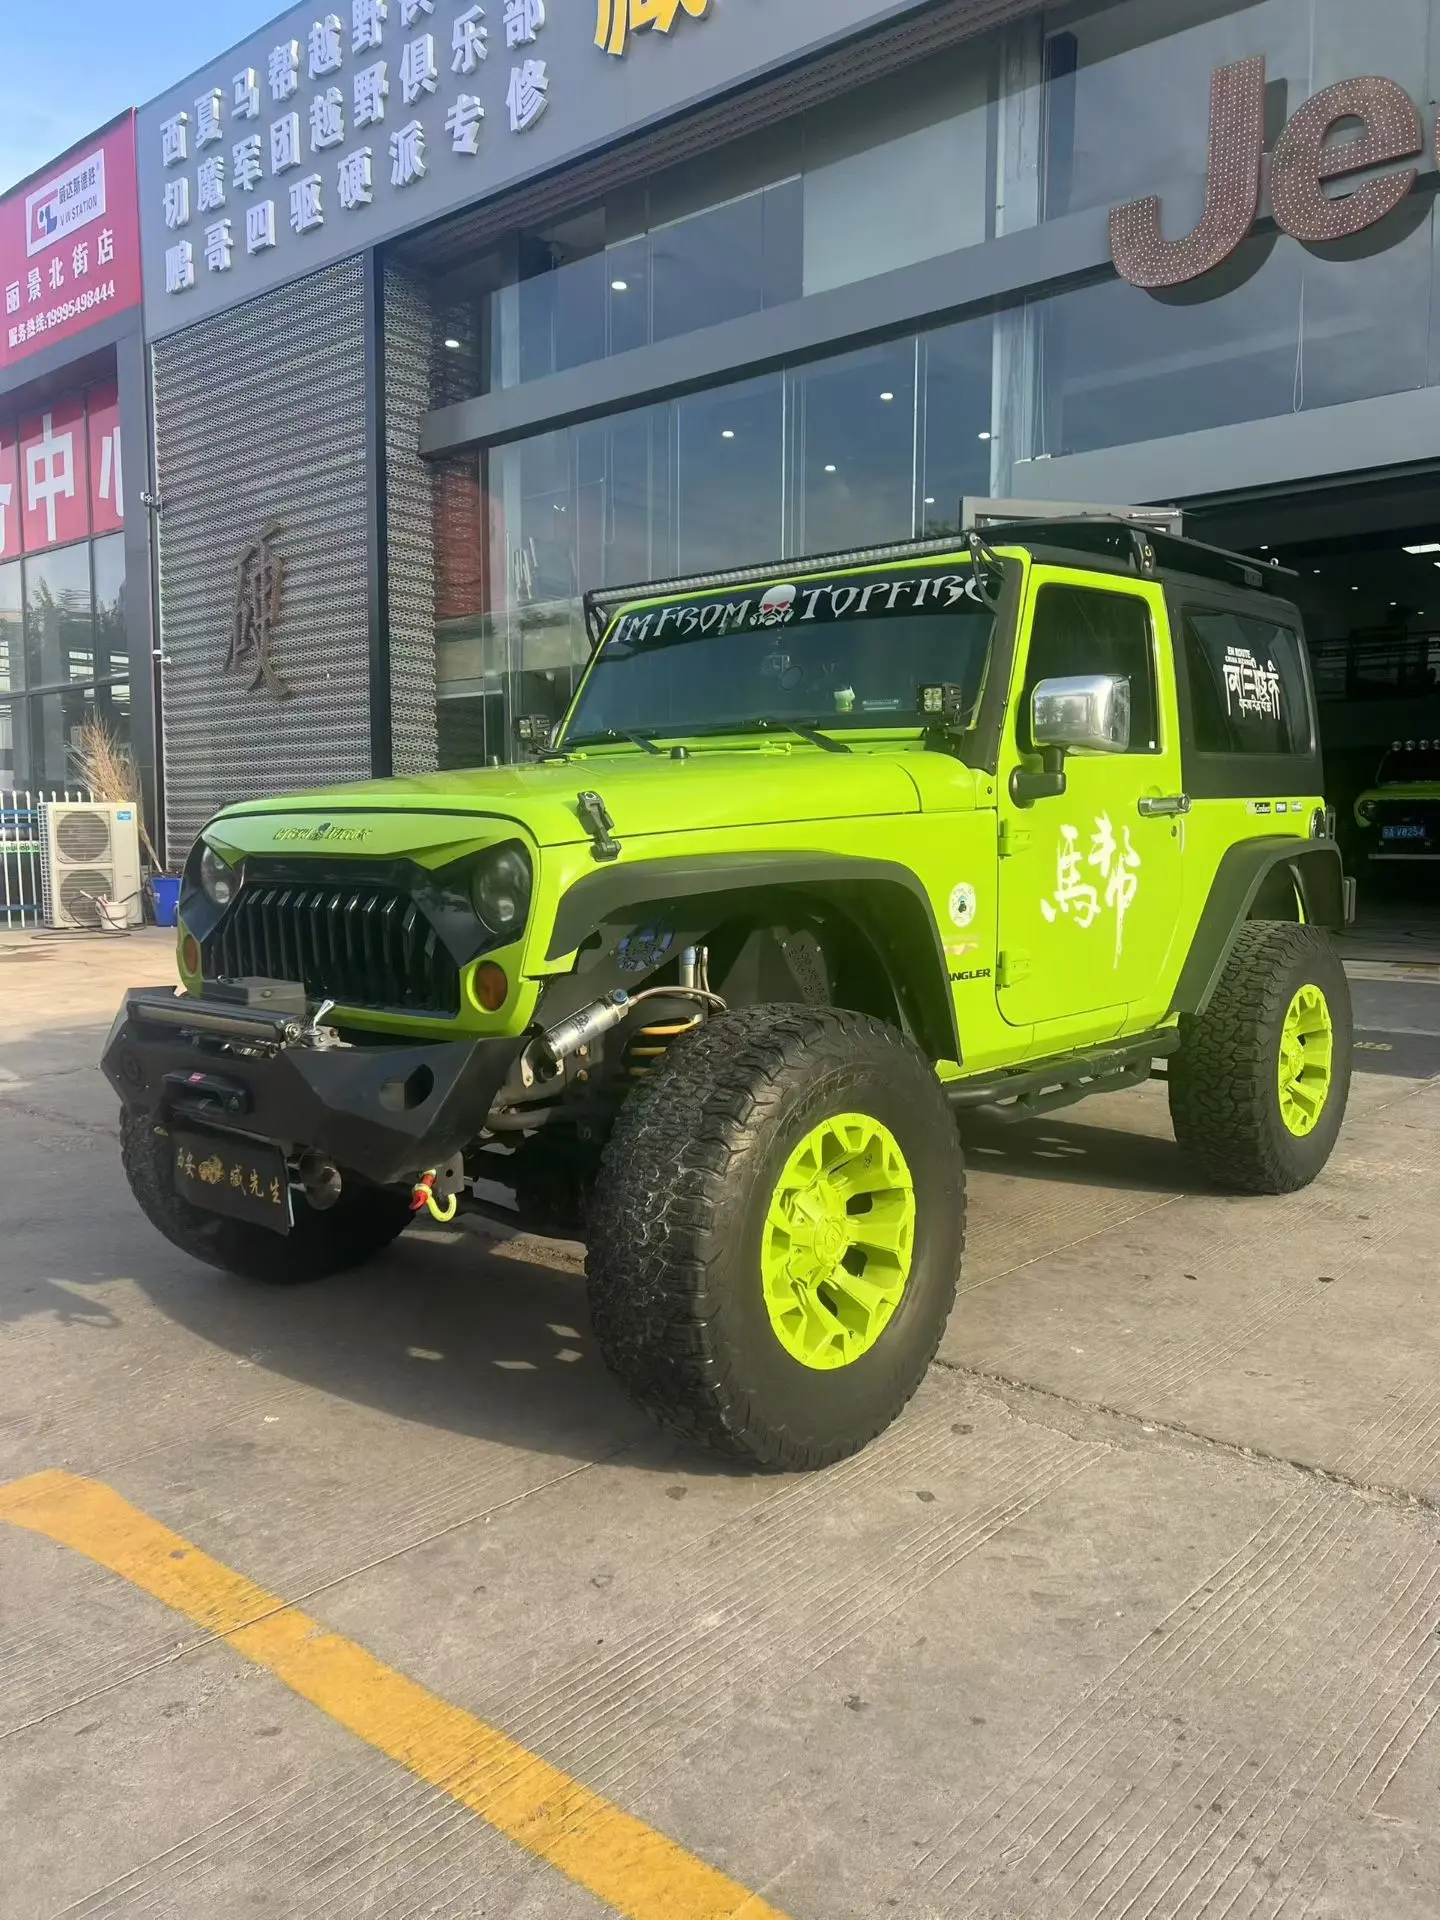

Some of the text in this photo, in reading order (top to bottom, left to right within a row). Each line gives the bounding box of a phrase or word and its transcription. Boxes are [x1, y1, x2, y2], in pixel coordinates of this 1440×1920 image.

[164, 58, 550, 294] 鹏哥四驱硬派专修
[1109, 56, 1440, 288] Je
[5, 228, 115, 315] 丽景北街店
[653, 599, 752, 637] FROM
